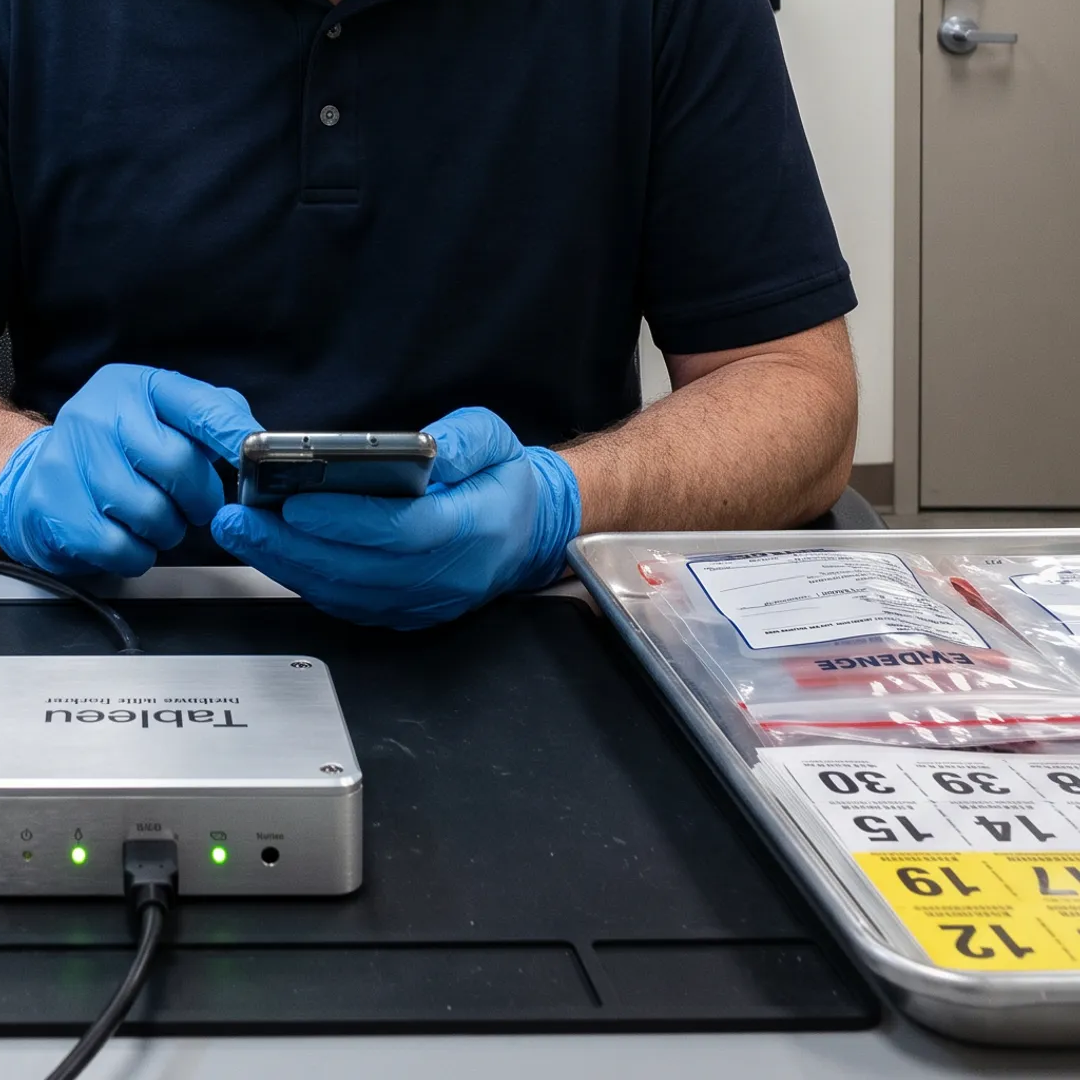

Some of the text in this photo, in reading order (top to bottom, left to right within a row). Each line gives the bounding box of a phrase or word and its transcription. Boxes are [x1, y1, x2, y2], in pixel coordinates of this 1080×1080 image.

[44, 709, 248, 728] Tableeu
[818, 771, 896, 795] 30
[932, 772, 1011, 795] 39
[853, 815, 934, 842] 15
[974, 815, 1057, 842] 14
[896, 867, 982, 897] 19
[938, 924, 1036, 960] 12
